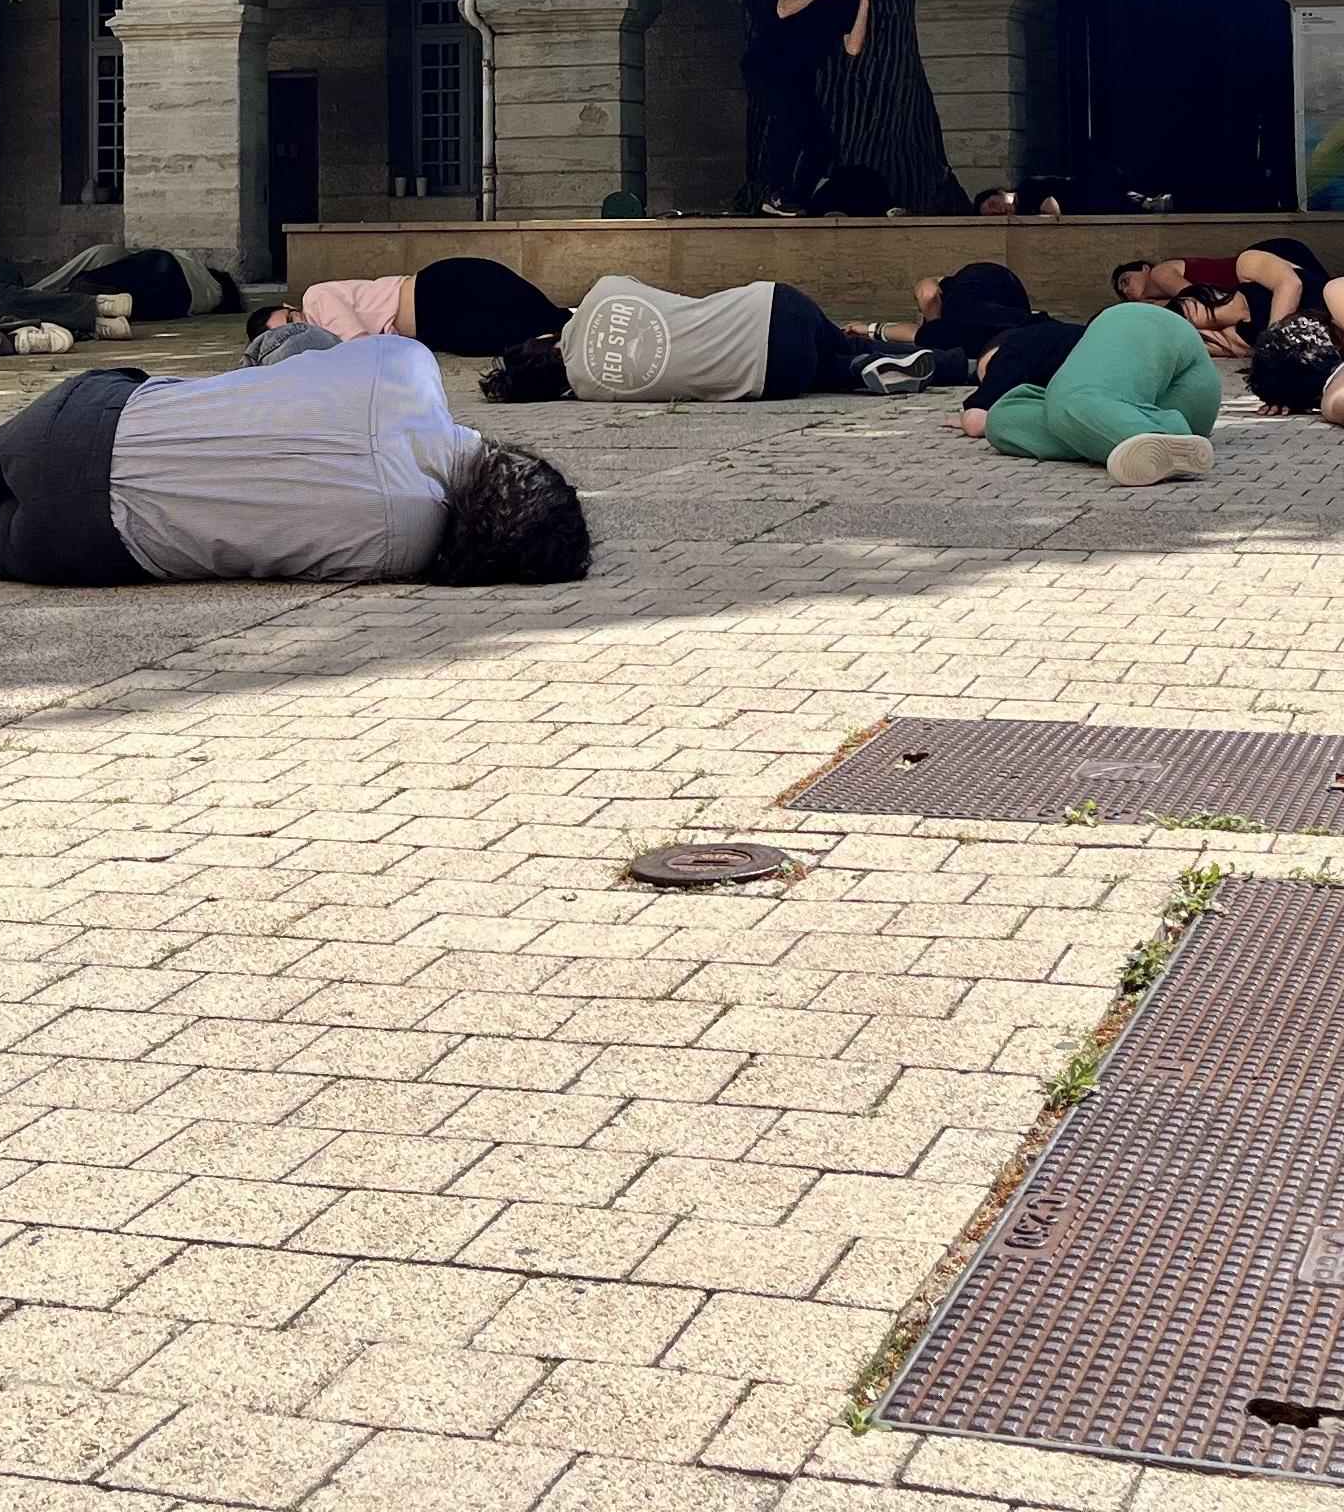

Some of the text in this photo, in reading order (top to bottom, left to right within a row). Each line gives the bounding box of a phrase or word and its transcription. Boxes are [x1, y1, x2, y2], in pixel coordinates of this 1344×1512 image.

[589, 313, 604, 335] VIDA
[601, 302, 636, 384] RED STAR
[642, 361, 658, 382] LIVE
[654, 347, 663, 360] TO
